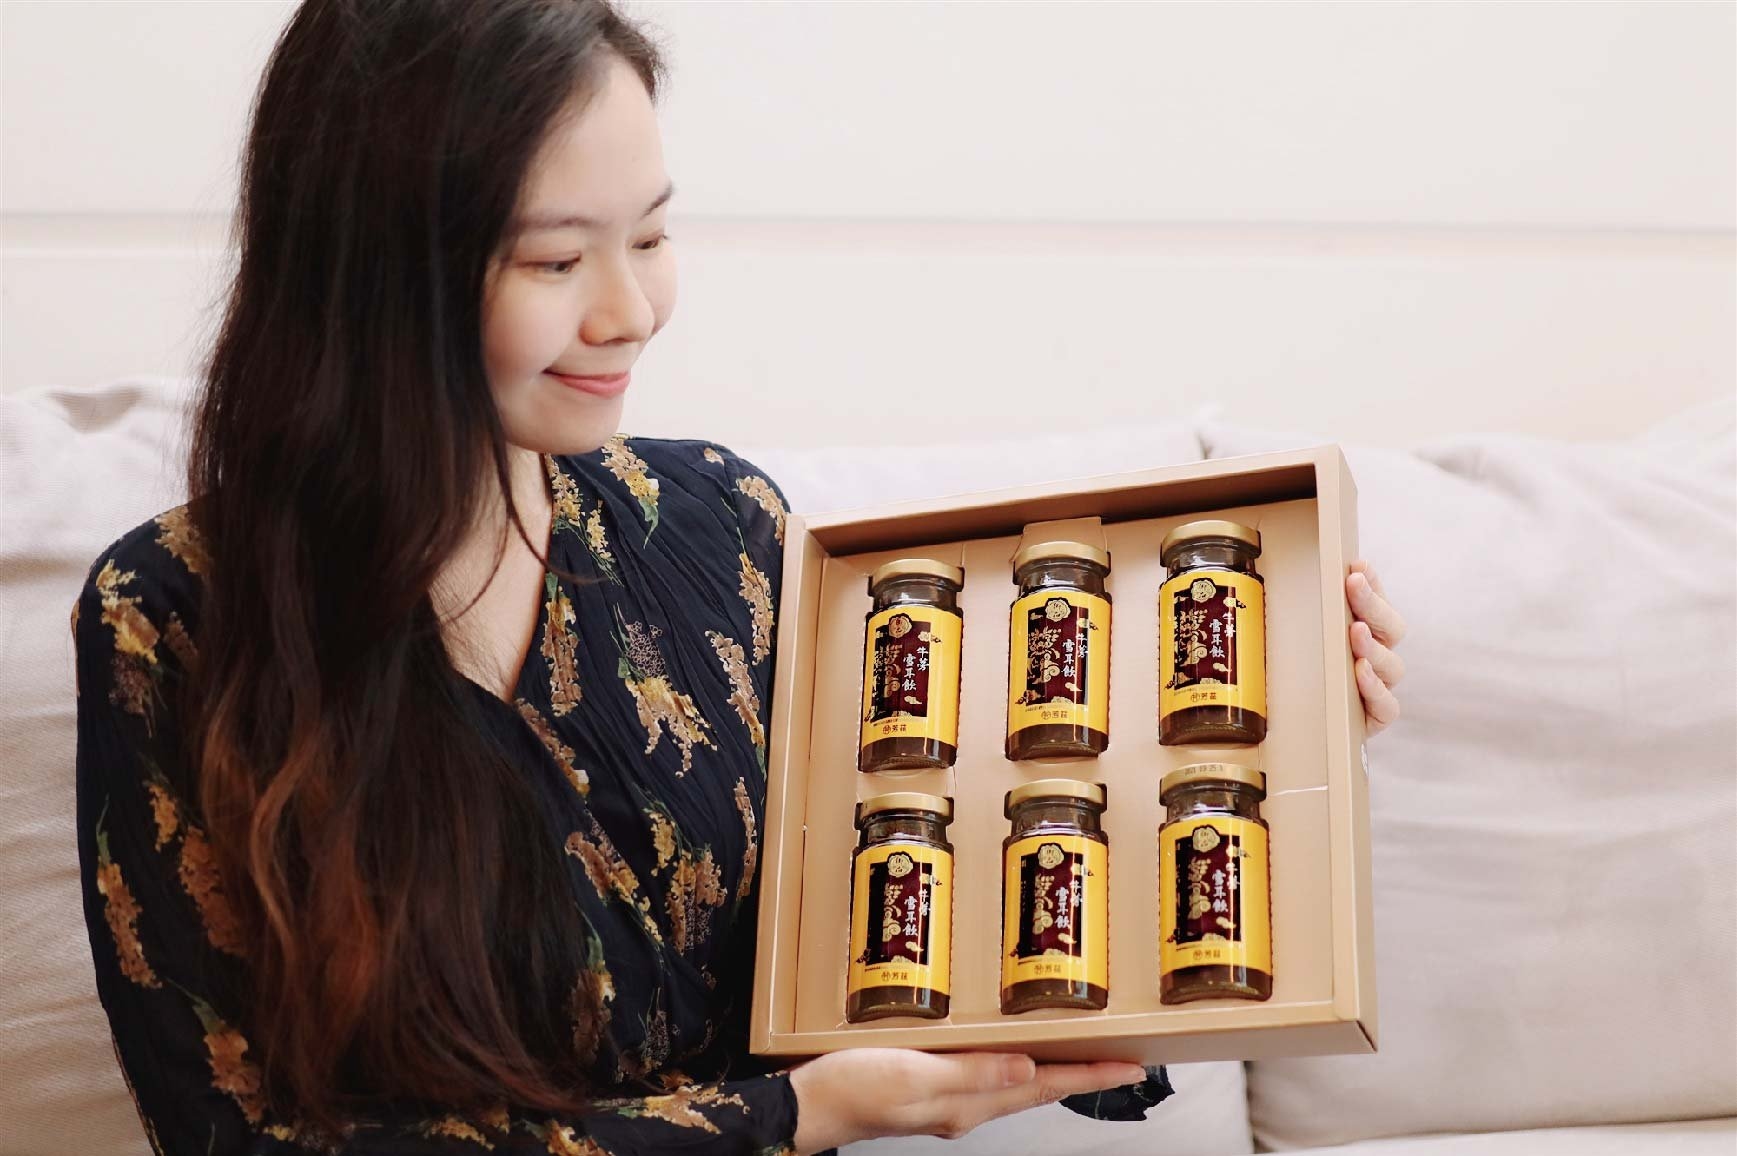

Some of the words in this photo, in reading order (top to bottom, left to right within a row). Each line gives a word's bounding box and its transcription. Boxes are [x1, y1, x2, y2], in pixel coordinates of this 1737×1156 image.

[1209, 618, 1225, 658] 雪耳飲
[902, 653, 917, 691] 雪耳飲
[916, 646, 930, 671] 牛蒡
[1062, 639, 1076, 677] 雪耳飲
[902, 896, 918, 936] 雪耳飲
